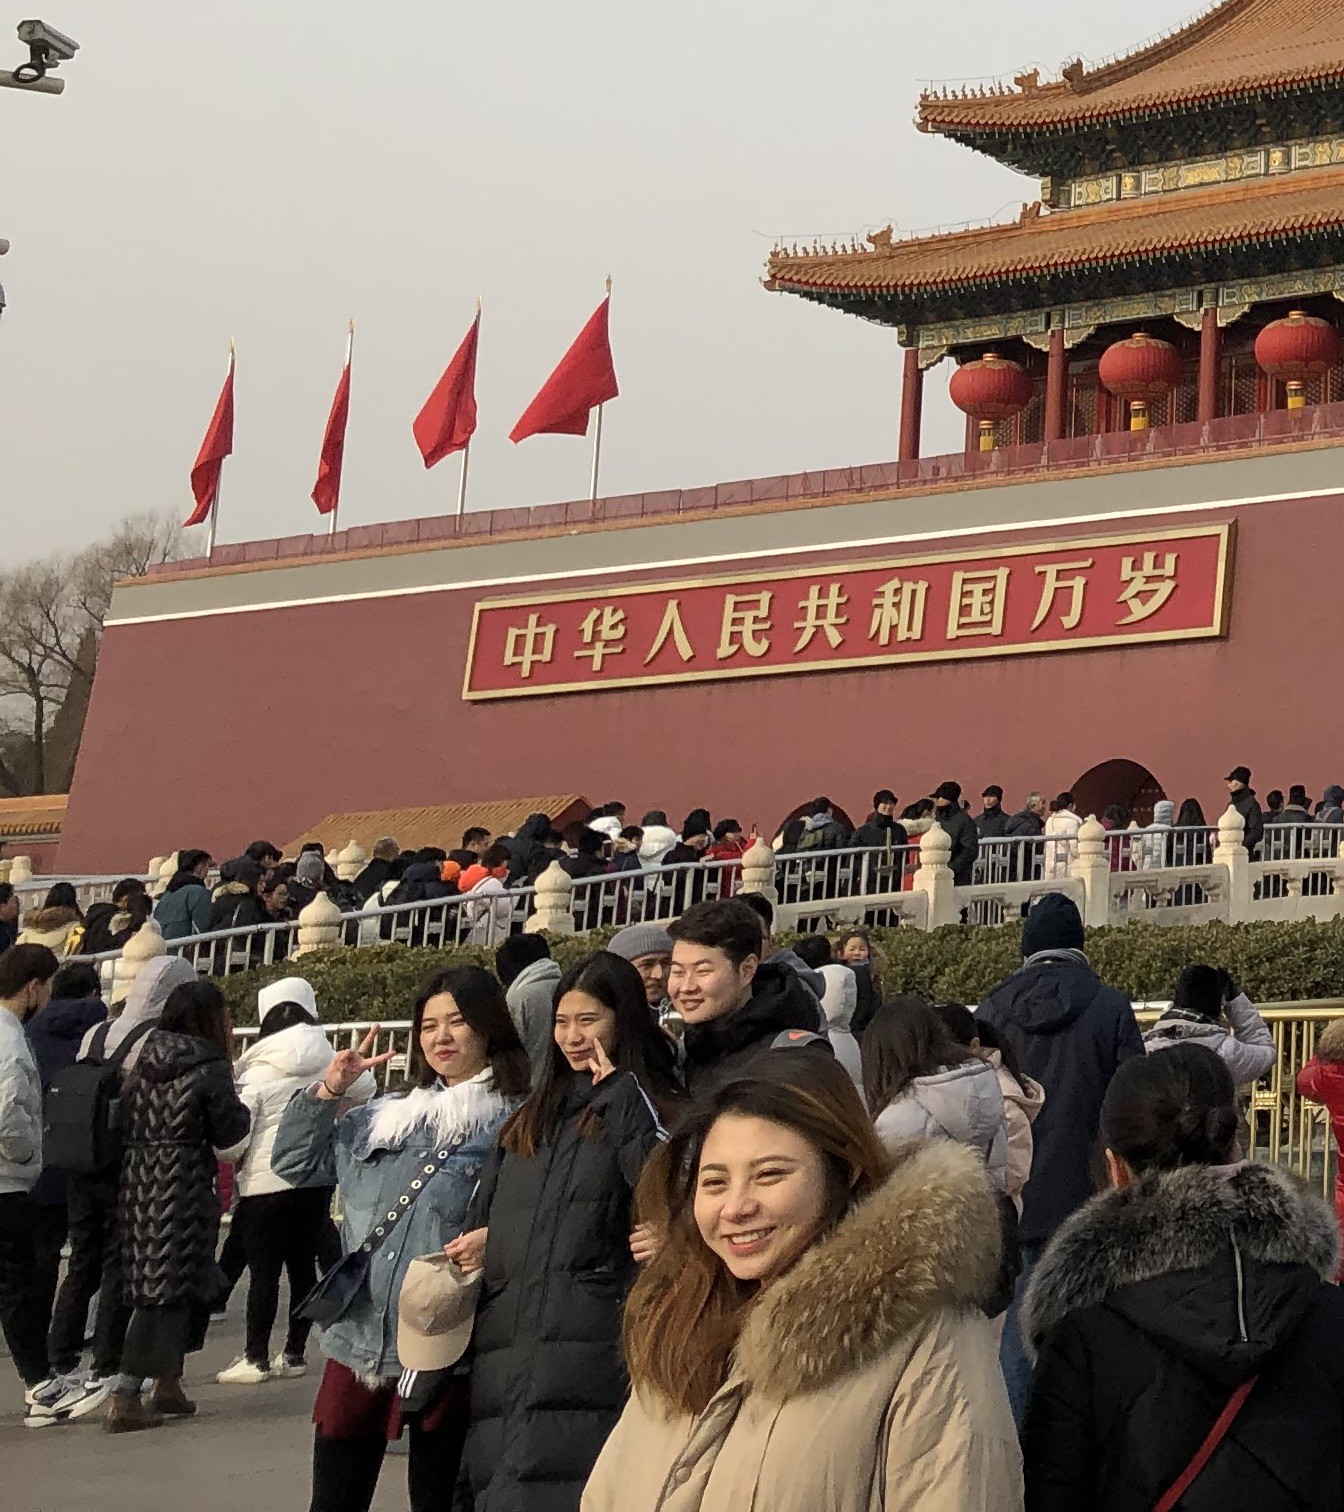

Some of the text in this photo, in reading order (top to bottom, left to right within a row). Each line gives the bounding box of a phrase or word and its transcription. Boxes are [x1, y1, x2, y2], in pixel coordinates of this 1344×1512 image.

[503, 551, 1178, 678] 中华人民共和国万岁
